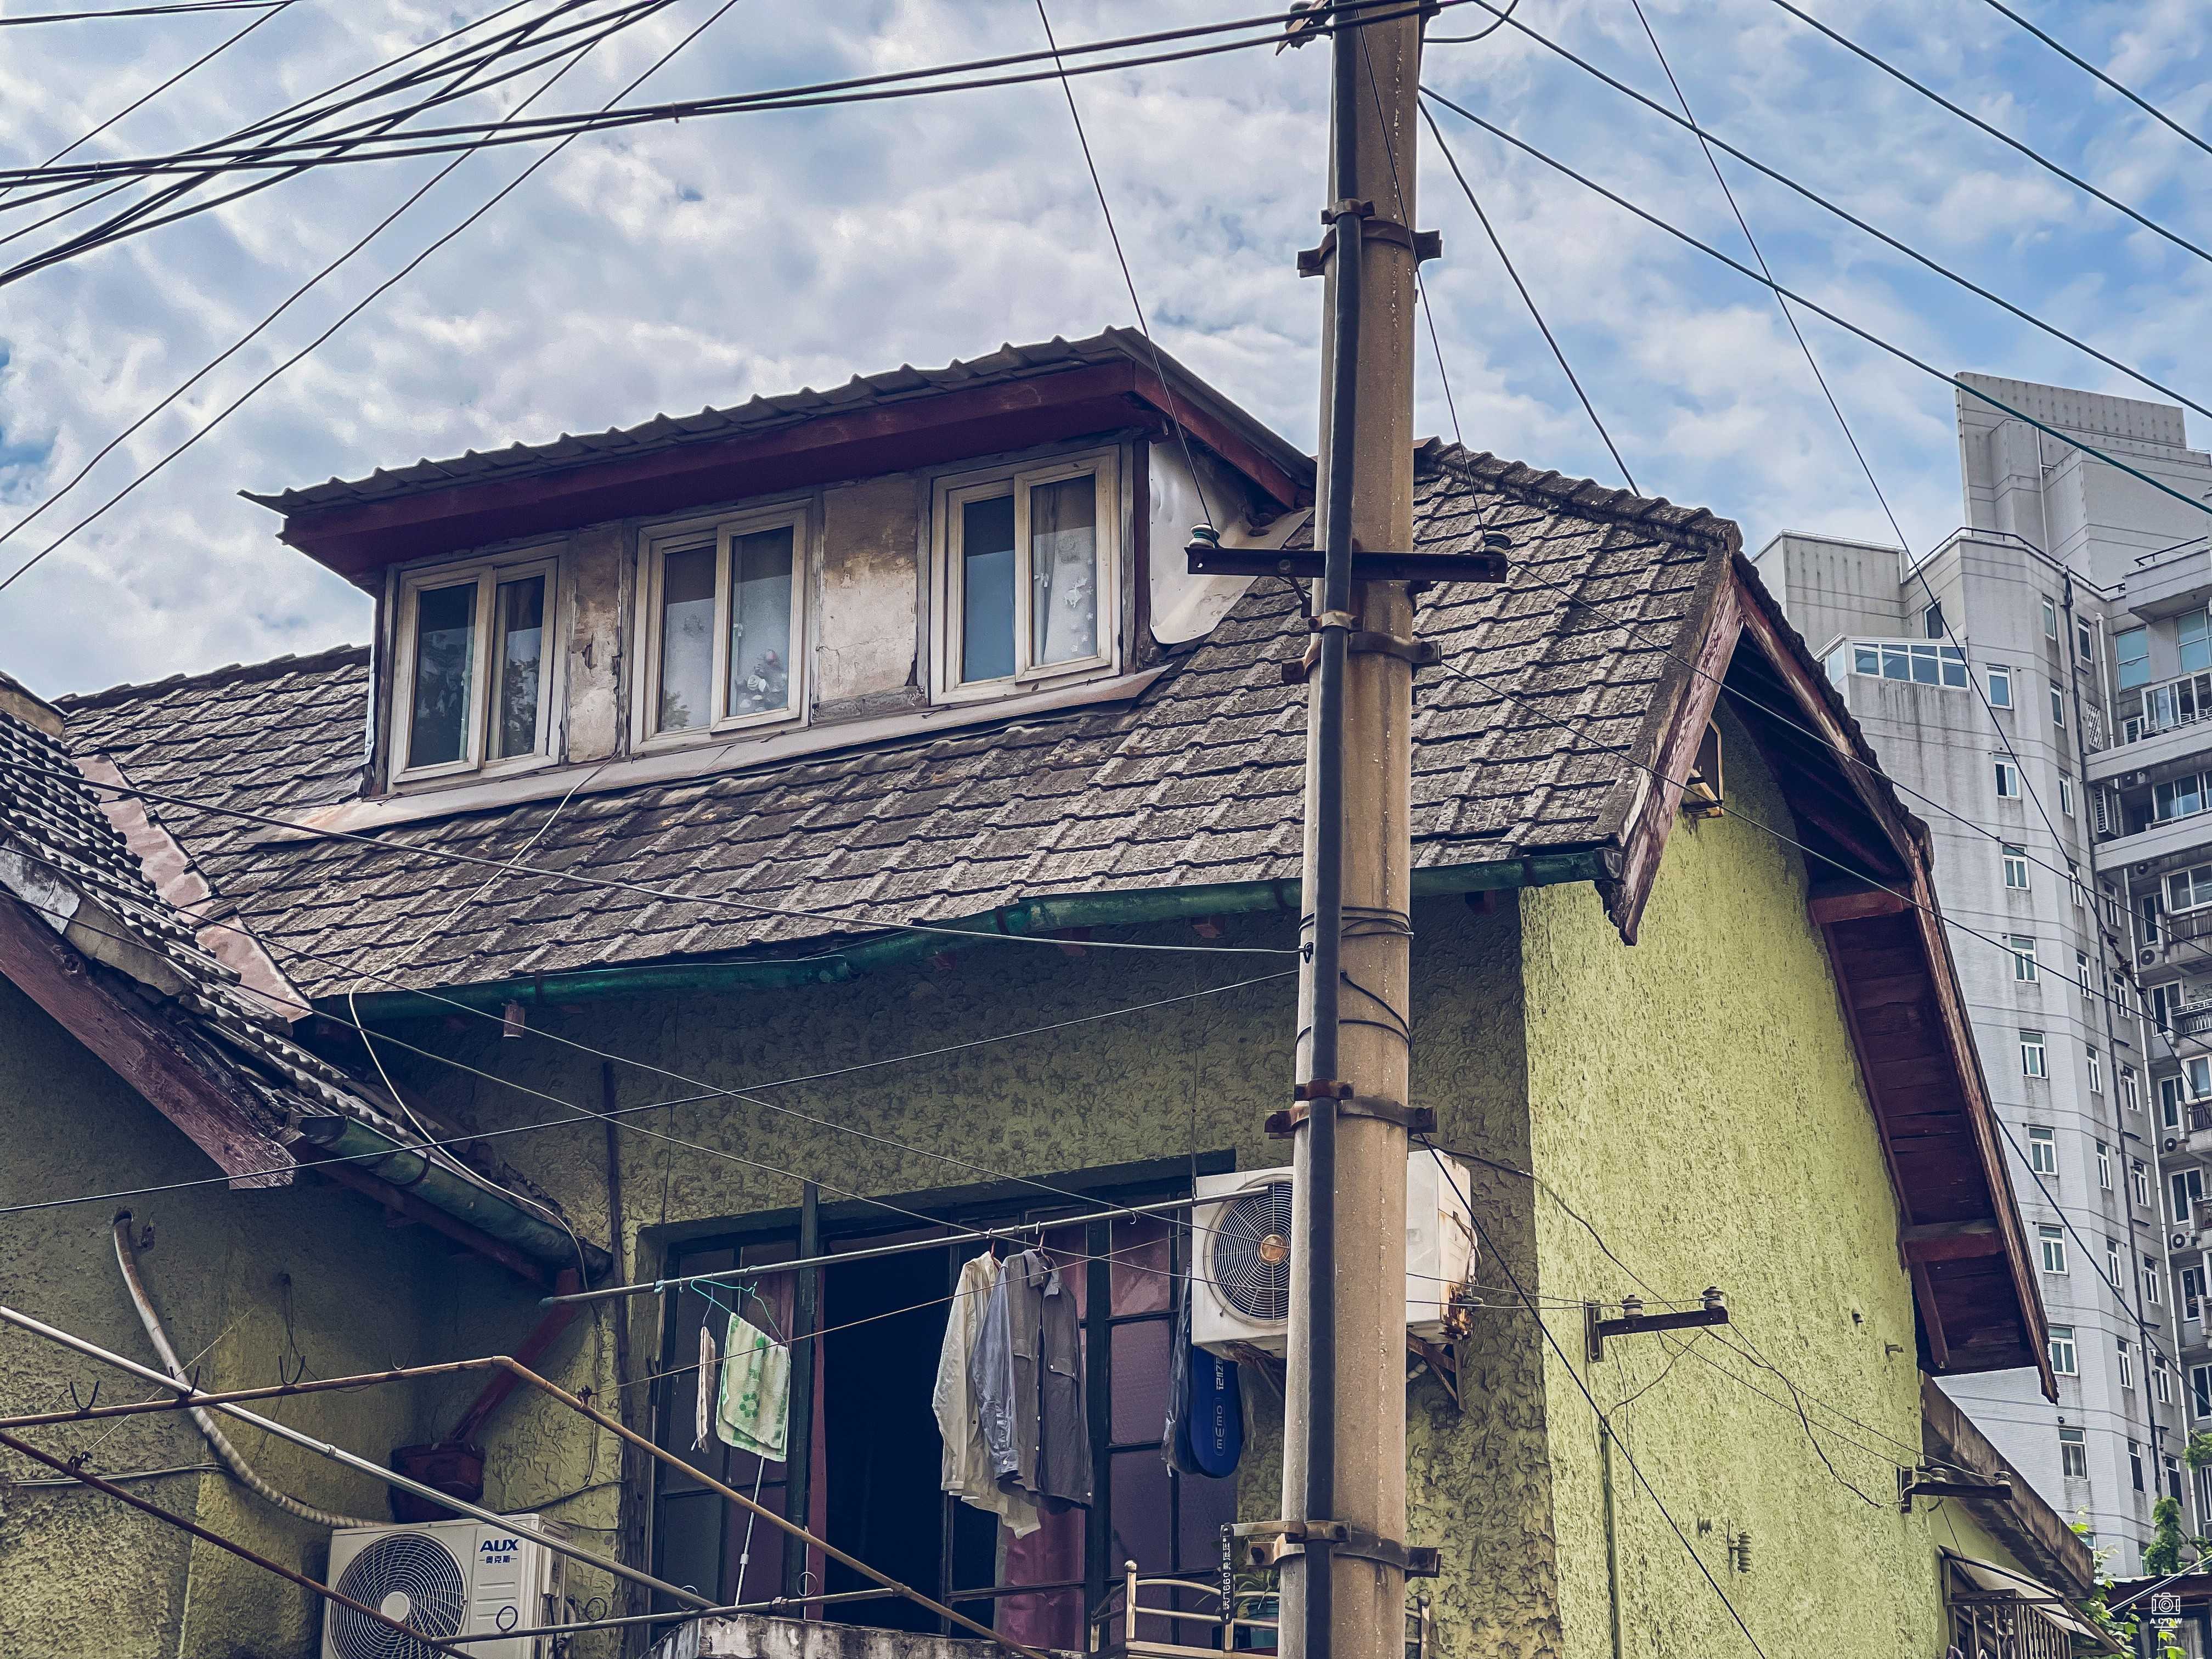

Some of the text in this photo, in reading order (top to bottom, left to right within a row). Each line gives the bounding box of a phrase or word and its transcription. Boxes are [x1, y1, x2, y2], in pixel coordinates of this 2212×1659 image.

[479, 1539, 520, 1553] AUX
[486, 1555, 511, 1564] 奥克斯
